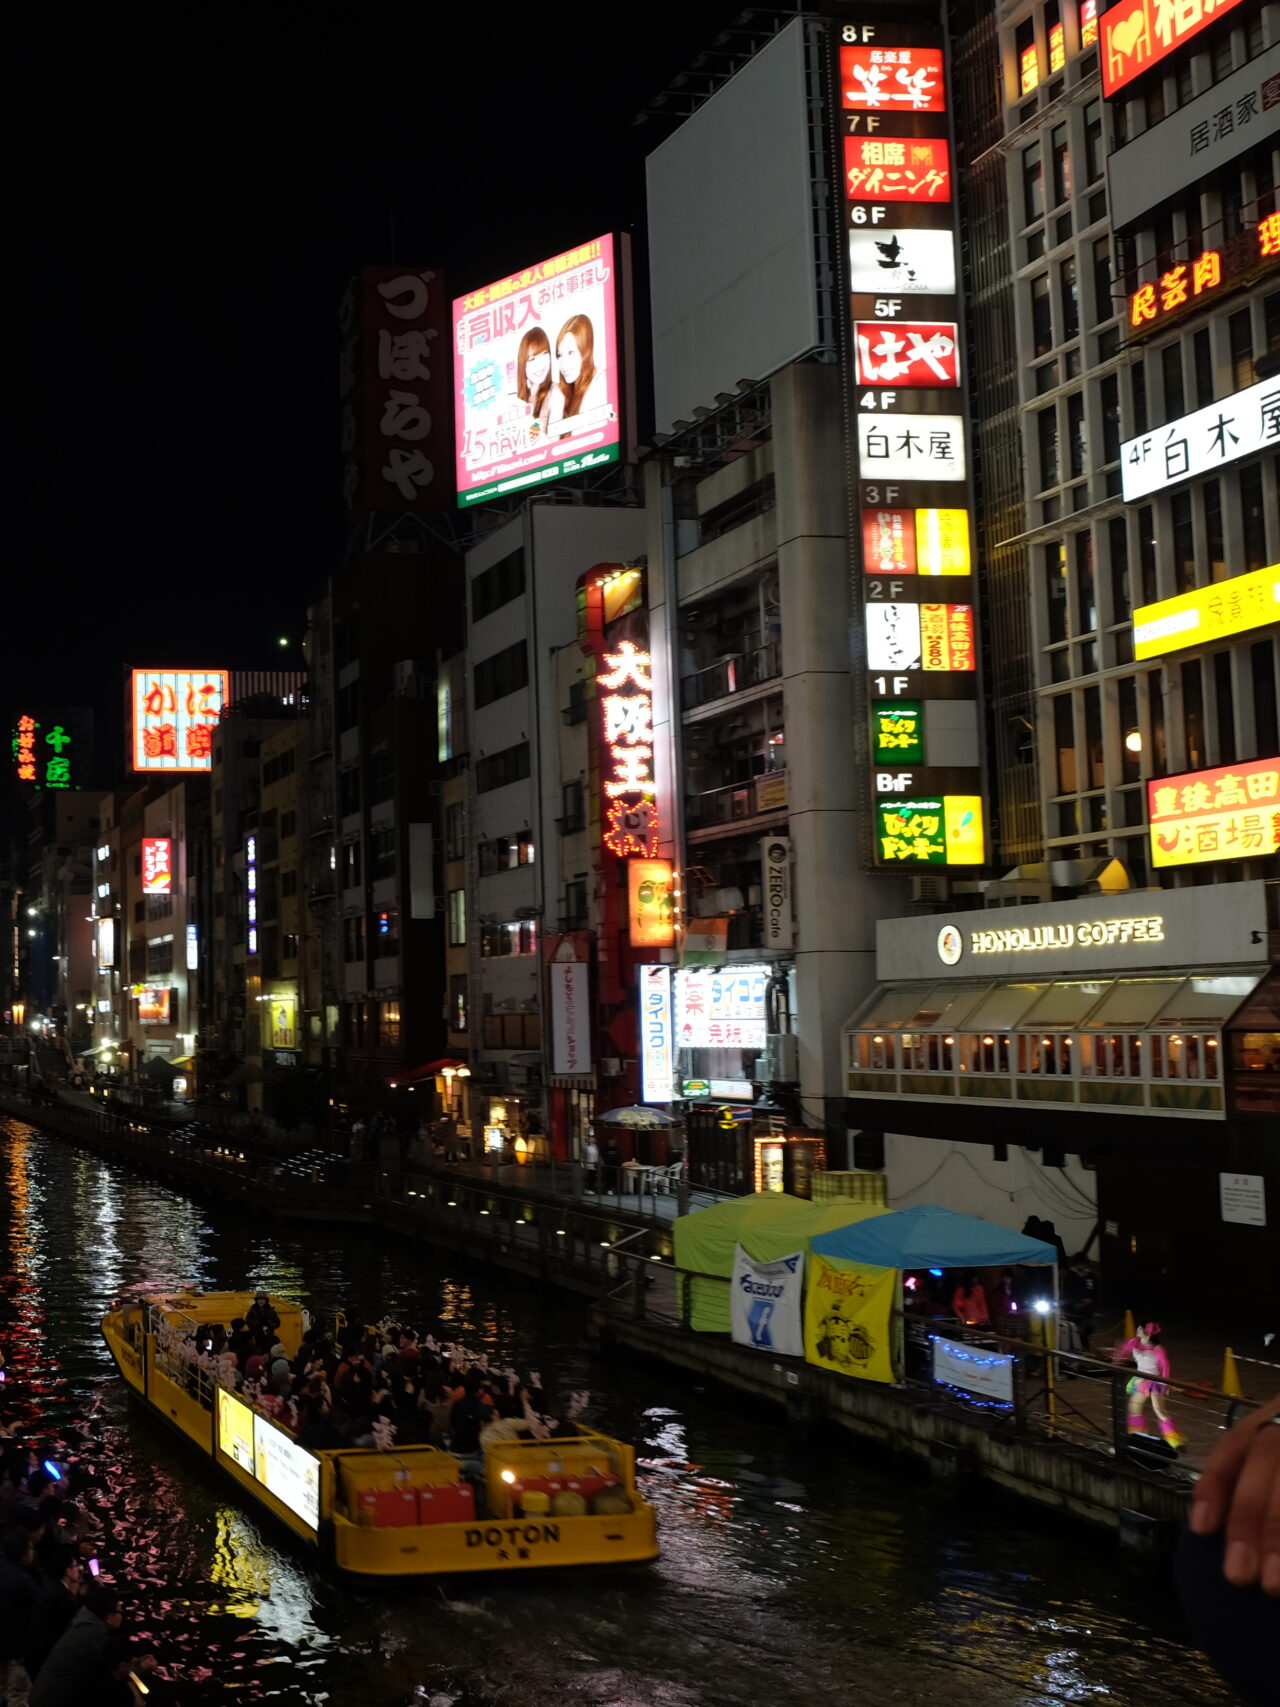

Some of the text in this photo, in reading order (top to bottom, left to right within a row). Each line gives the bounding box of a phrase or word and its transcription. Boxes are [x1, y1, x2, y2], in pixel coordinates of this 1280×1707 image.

[841, 25, 875, 42] 8F
[846, 65, 936, 108] 笑笑
[847, 115, 880, 132] 7F
[1189, 90, 1259, 157] 居酒家
[861, 142, 905, 166] 相席
[847, 167, 948, 196] ダイニング
[851, 206, 886, 224] 6F
[874, 299, 901, 317] 5F
[468, 293, 542, 350] 高収入
[377, 269, 438, 501] づぼらや
[860, 391, 896, 410] 4F
[866, 425, 955, 460] 白木屋
[1129, 437, 1153, 467] 4F
[865, 486, 900, 503] 3F
[870, 581, 904, 599] 2F
[874, 676, 909, 695] 1F
[142, 680, 220, 718] かに
[1151, 770, 1280, 819] 豊後高田
[882, 811, 940, 836] びっくり
[1184, 815, 1266, 854] 酒場
[880, 837, 944, 860] ドンキー
[970, 915, 1165, 955] HONOLULU COFFEE
[465, 1523, 562, 1548] DOTON
